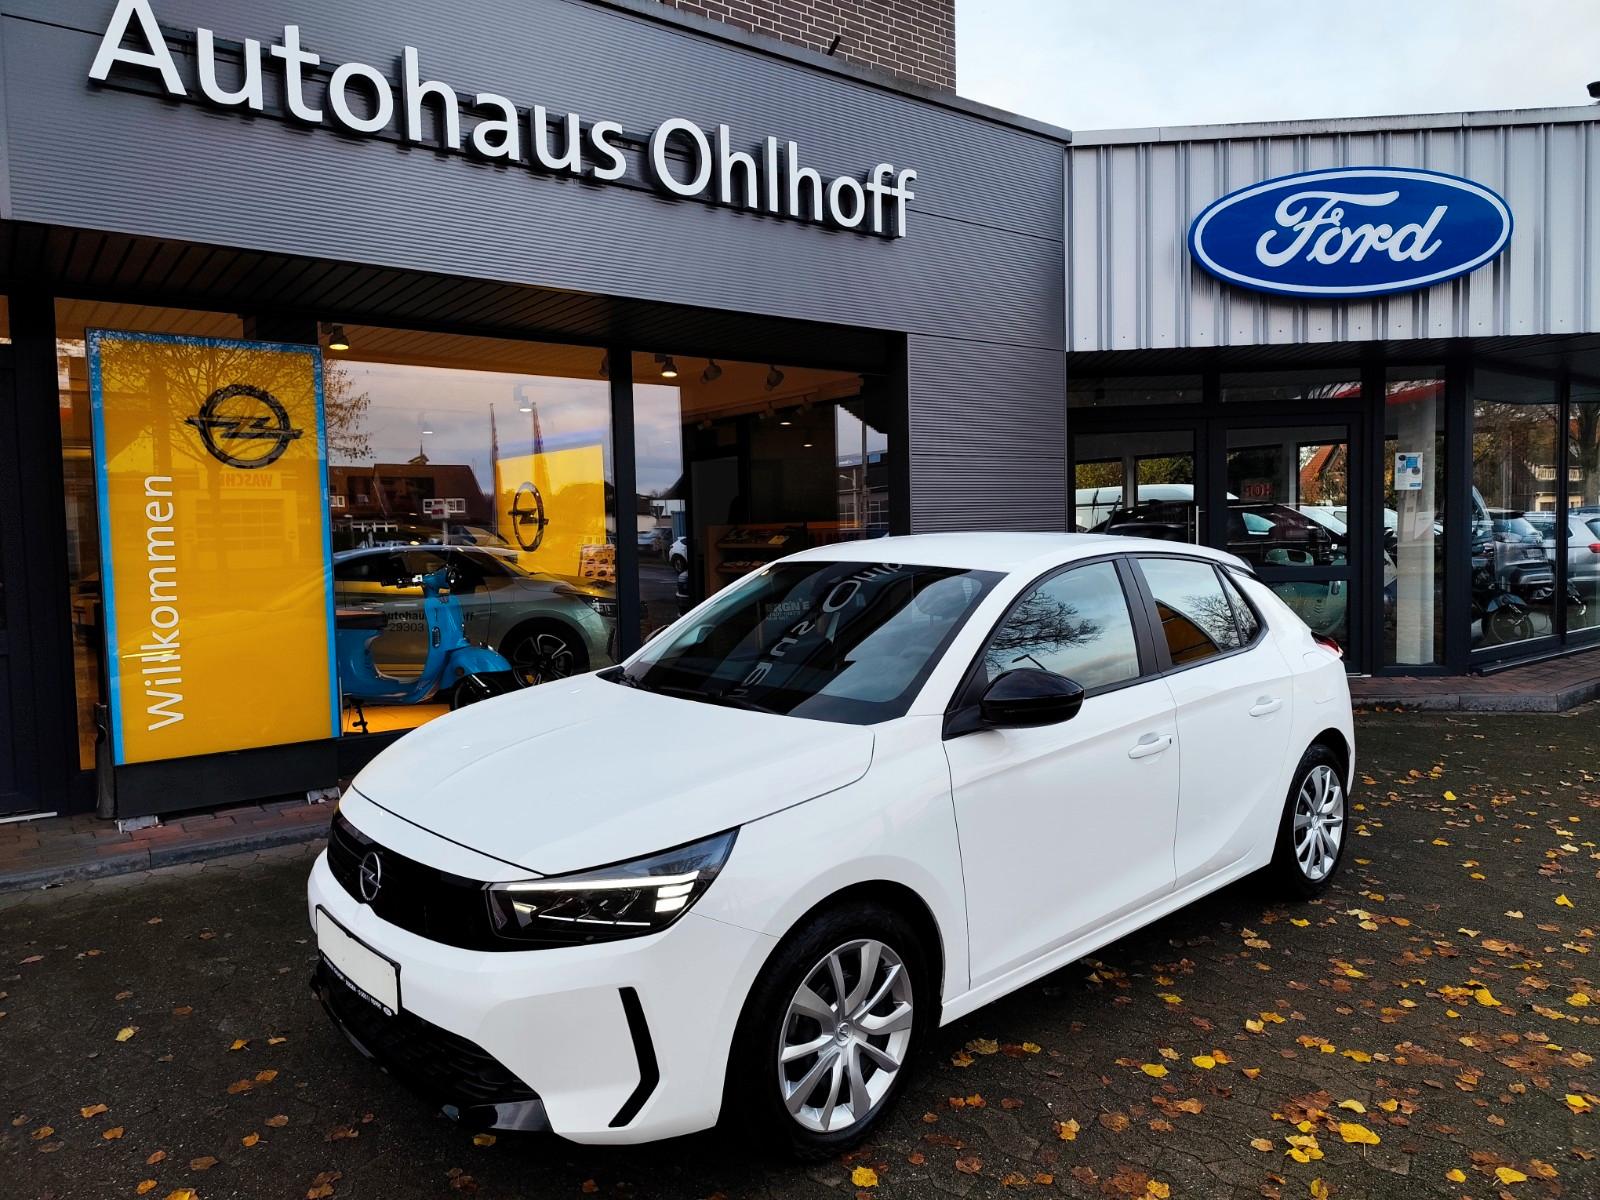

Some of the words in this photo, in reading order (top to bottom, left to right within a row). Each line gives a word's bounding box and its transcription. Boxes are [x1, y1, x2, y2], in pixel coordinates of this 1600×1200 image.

[88, 0, 627, 182] Autohaus
[648, 116, 918, 239] Ohlhoff
[1255, 190, 1448, 267] Ford
[140, 474, 185, 731] Willkommen
